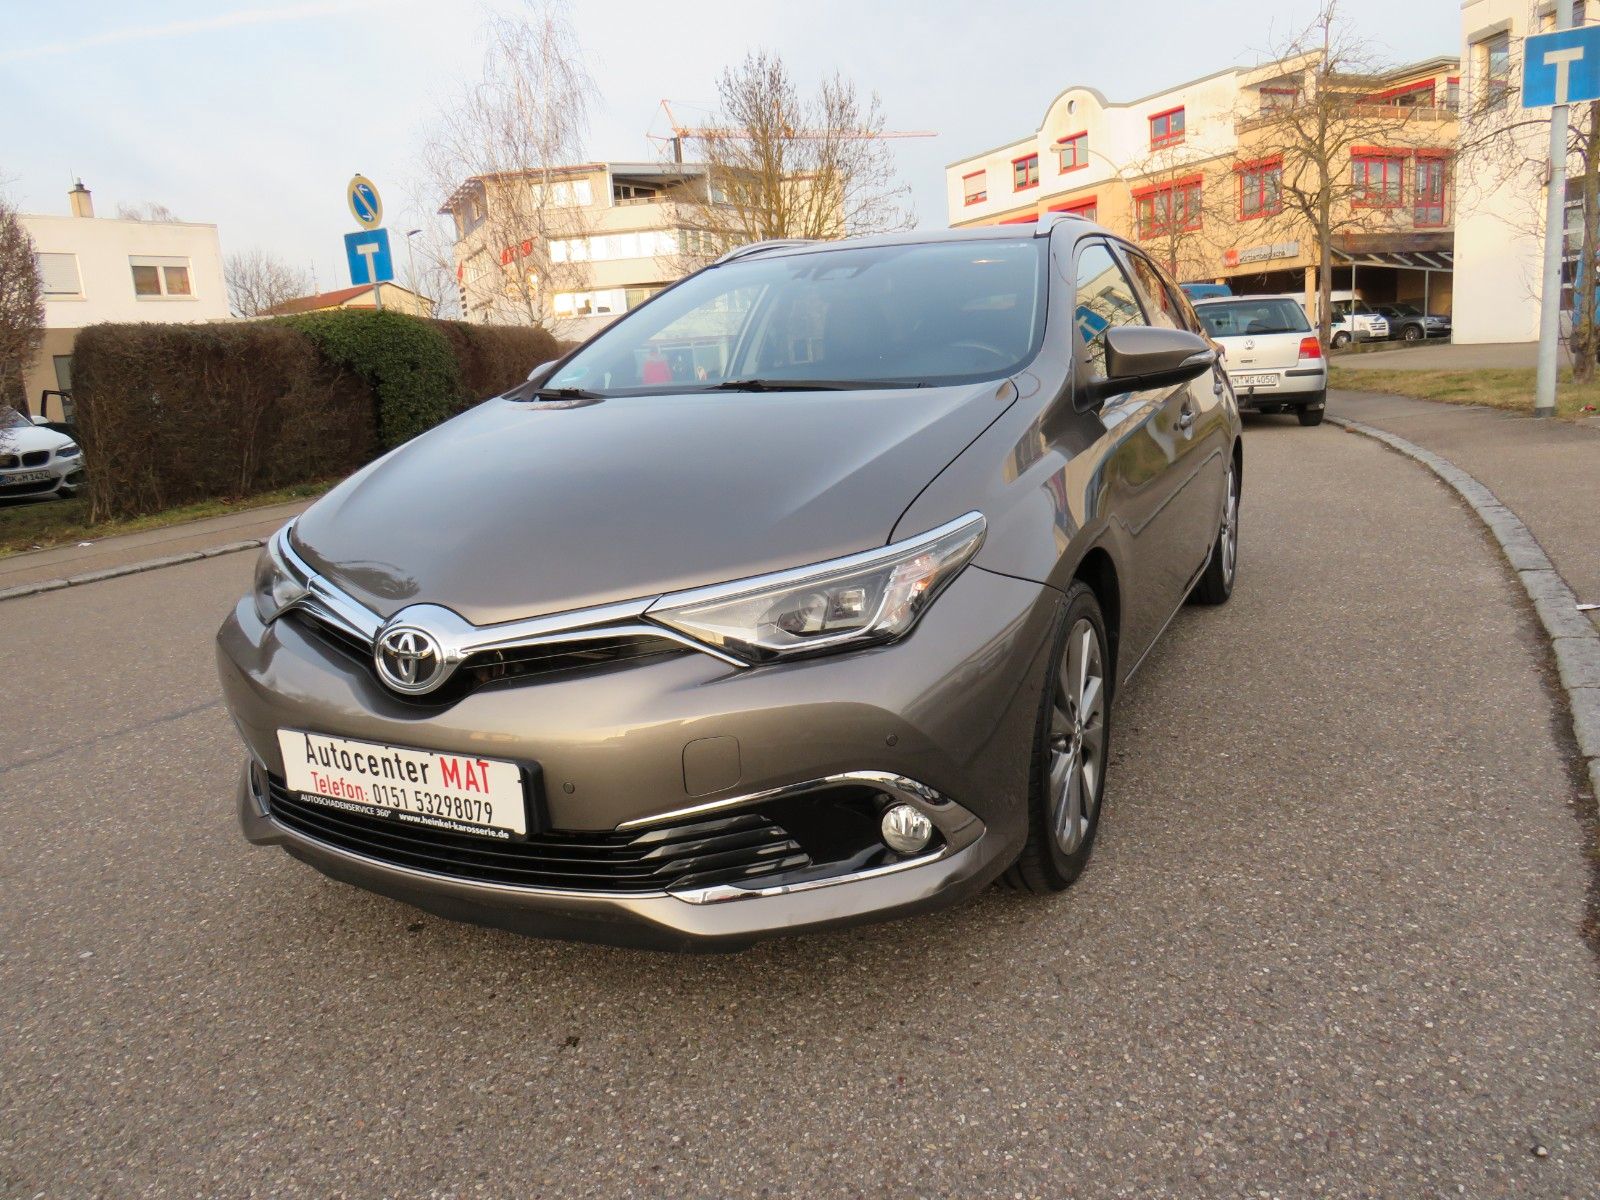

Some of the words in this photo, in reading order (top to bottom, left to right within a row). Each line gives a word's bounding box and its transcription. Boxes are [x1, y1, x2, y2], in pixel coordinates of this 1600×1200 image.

[1256, 375, 1275, 384] 4050
[304, 733, 429, 785] Autocenter
[439, 756, 490, 794] MAT
[300, 794, 375, 815] AUTOSCHADENSERVICE
[399, 812, 510, 840] www.heinkel-karosserie.de
[311, 771, 369, 802] Telefon:
[372, 783, 409, 810] 0151
[414, 790, 493, 824] 53298079
